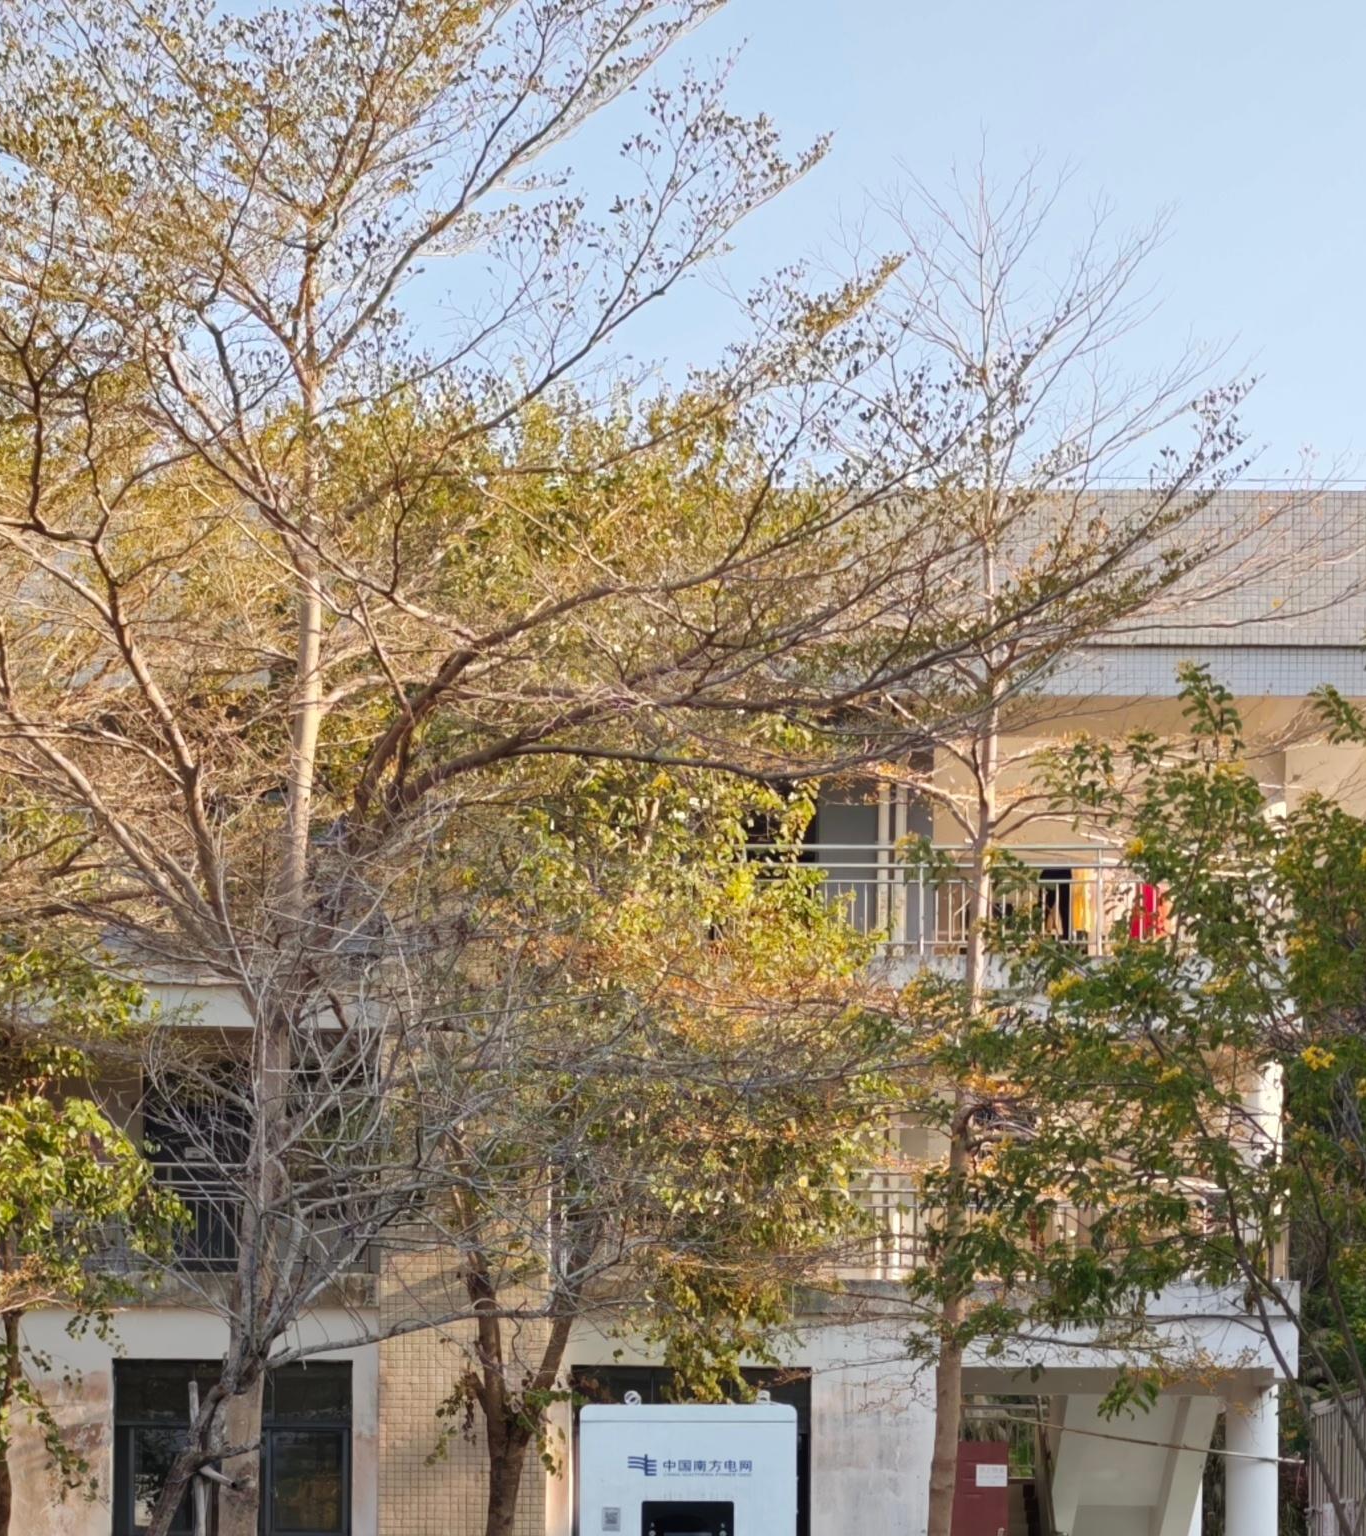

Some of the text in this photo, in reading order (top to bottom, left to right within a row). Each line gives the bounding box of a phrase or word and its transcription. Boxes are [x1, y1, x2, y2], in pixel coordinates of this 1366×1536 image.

[663, 1459, 753, 1473] 中国南方电网
